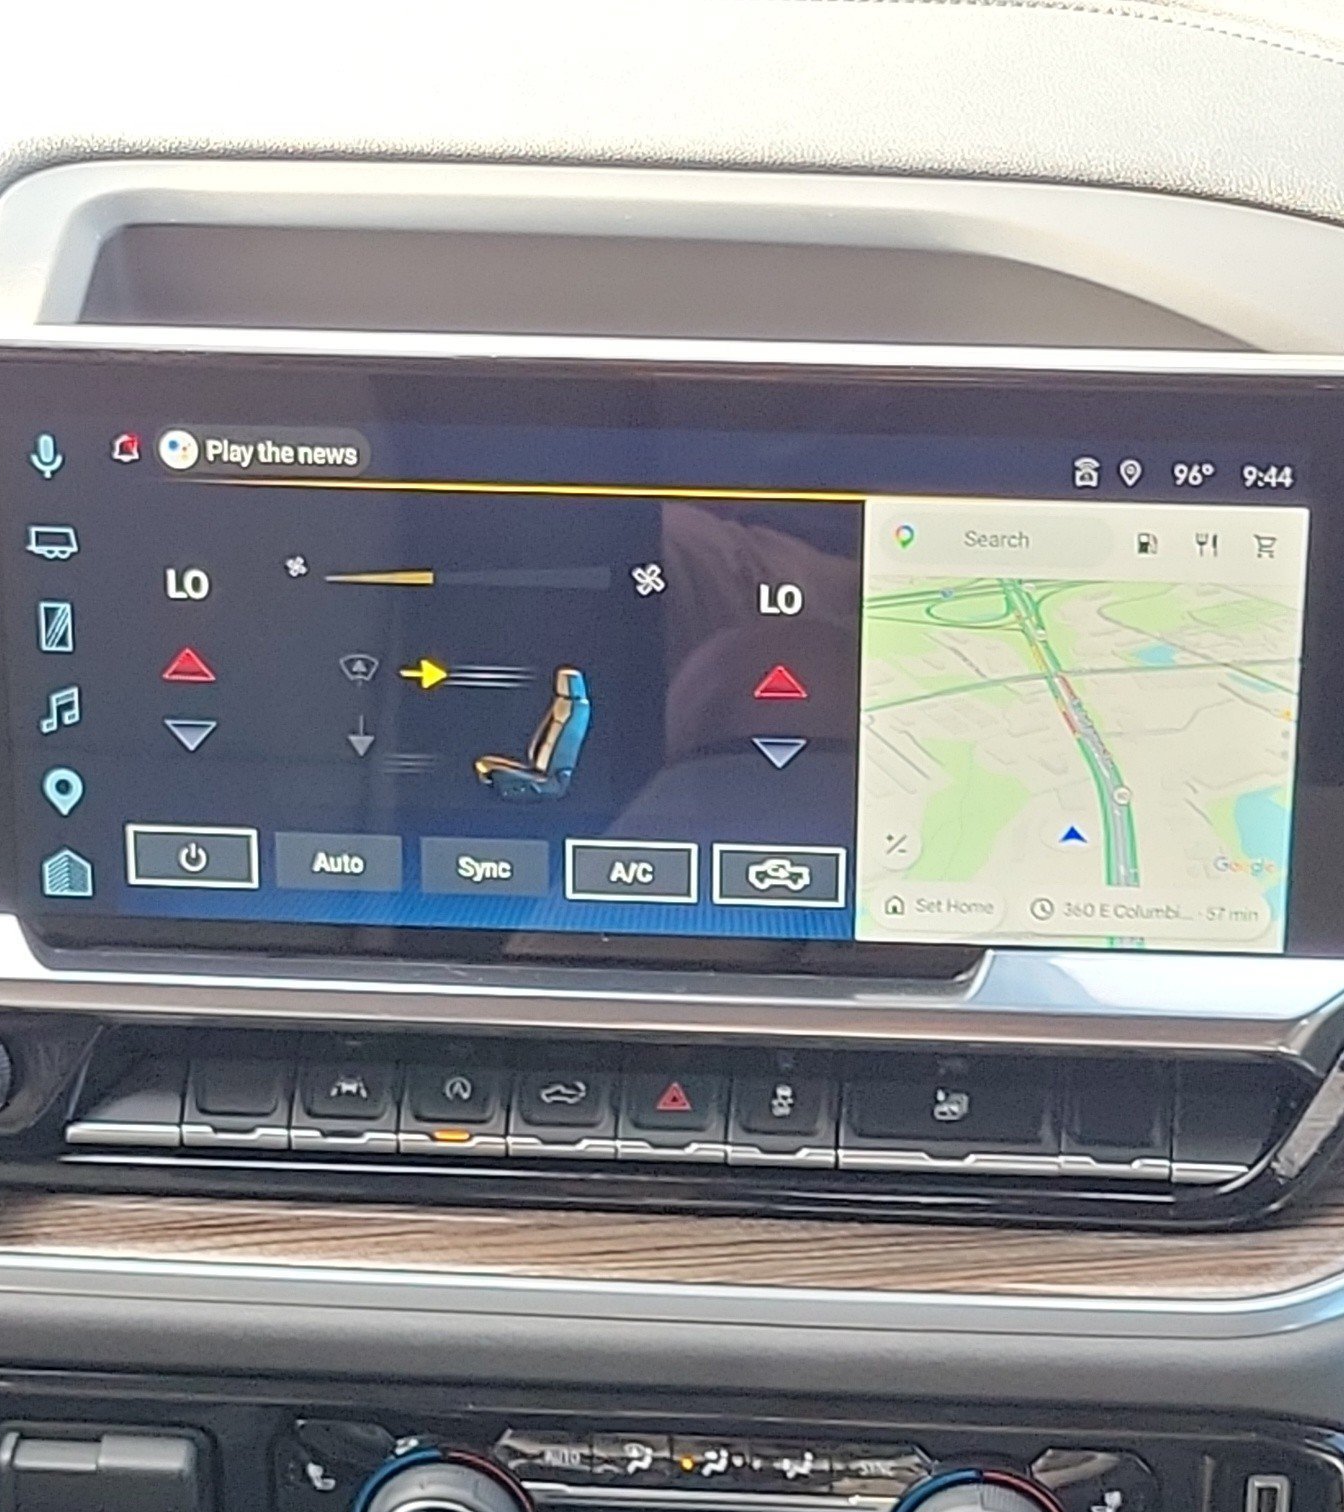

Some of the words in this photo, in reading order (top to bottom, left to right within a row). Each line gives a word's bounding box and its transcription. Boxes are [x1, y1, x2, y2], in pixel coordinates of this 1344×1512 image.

[206, 440, 254, 468] Play
[258, 440, 297, 465] the
[301, 446, 359, 467] news
[1173, 462, 1215, 486] 96°
[1242, 465, 1295, 488] 9:44
[964, 530, 1030, 551] Search
[165, 568, 210, 599] LO
[759, 584, 803, 616] LO
[313, 851, 364, 876] Auto
[458, 854, 513, 882] Sync
[609, 860, 655, 884] A/C
[915, 897, 944, 914] Set
[947, 900, 995, 916] Home
[1062, 902, 1094, 918] 360
[1099, 904, 1110, 918] E
[1228, 907, 1259, 922] min
